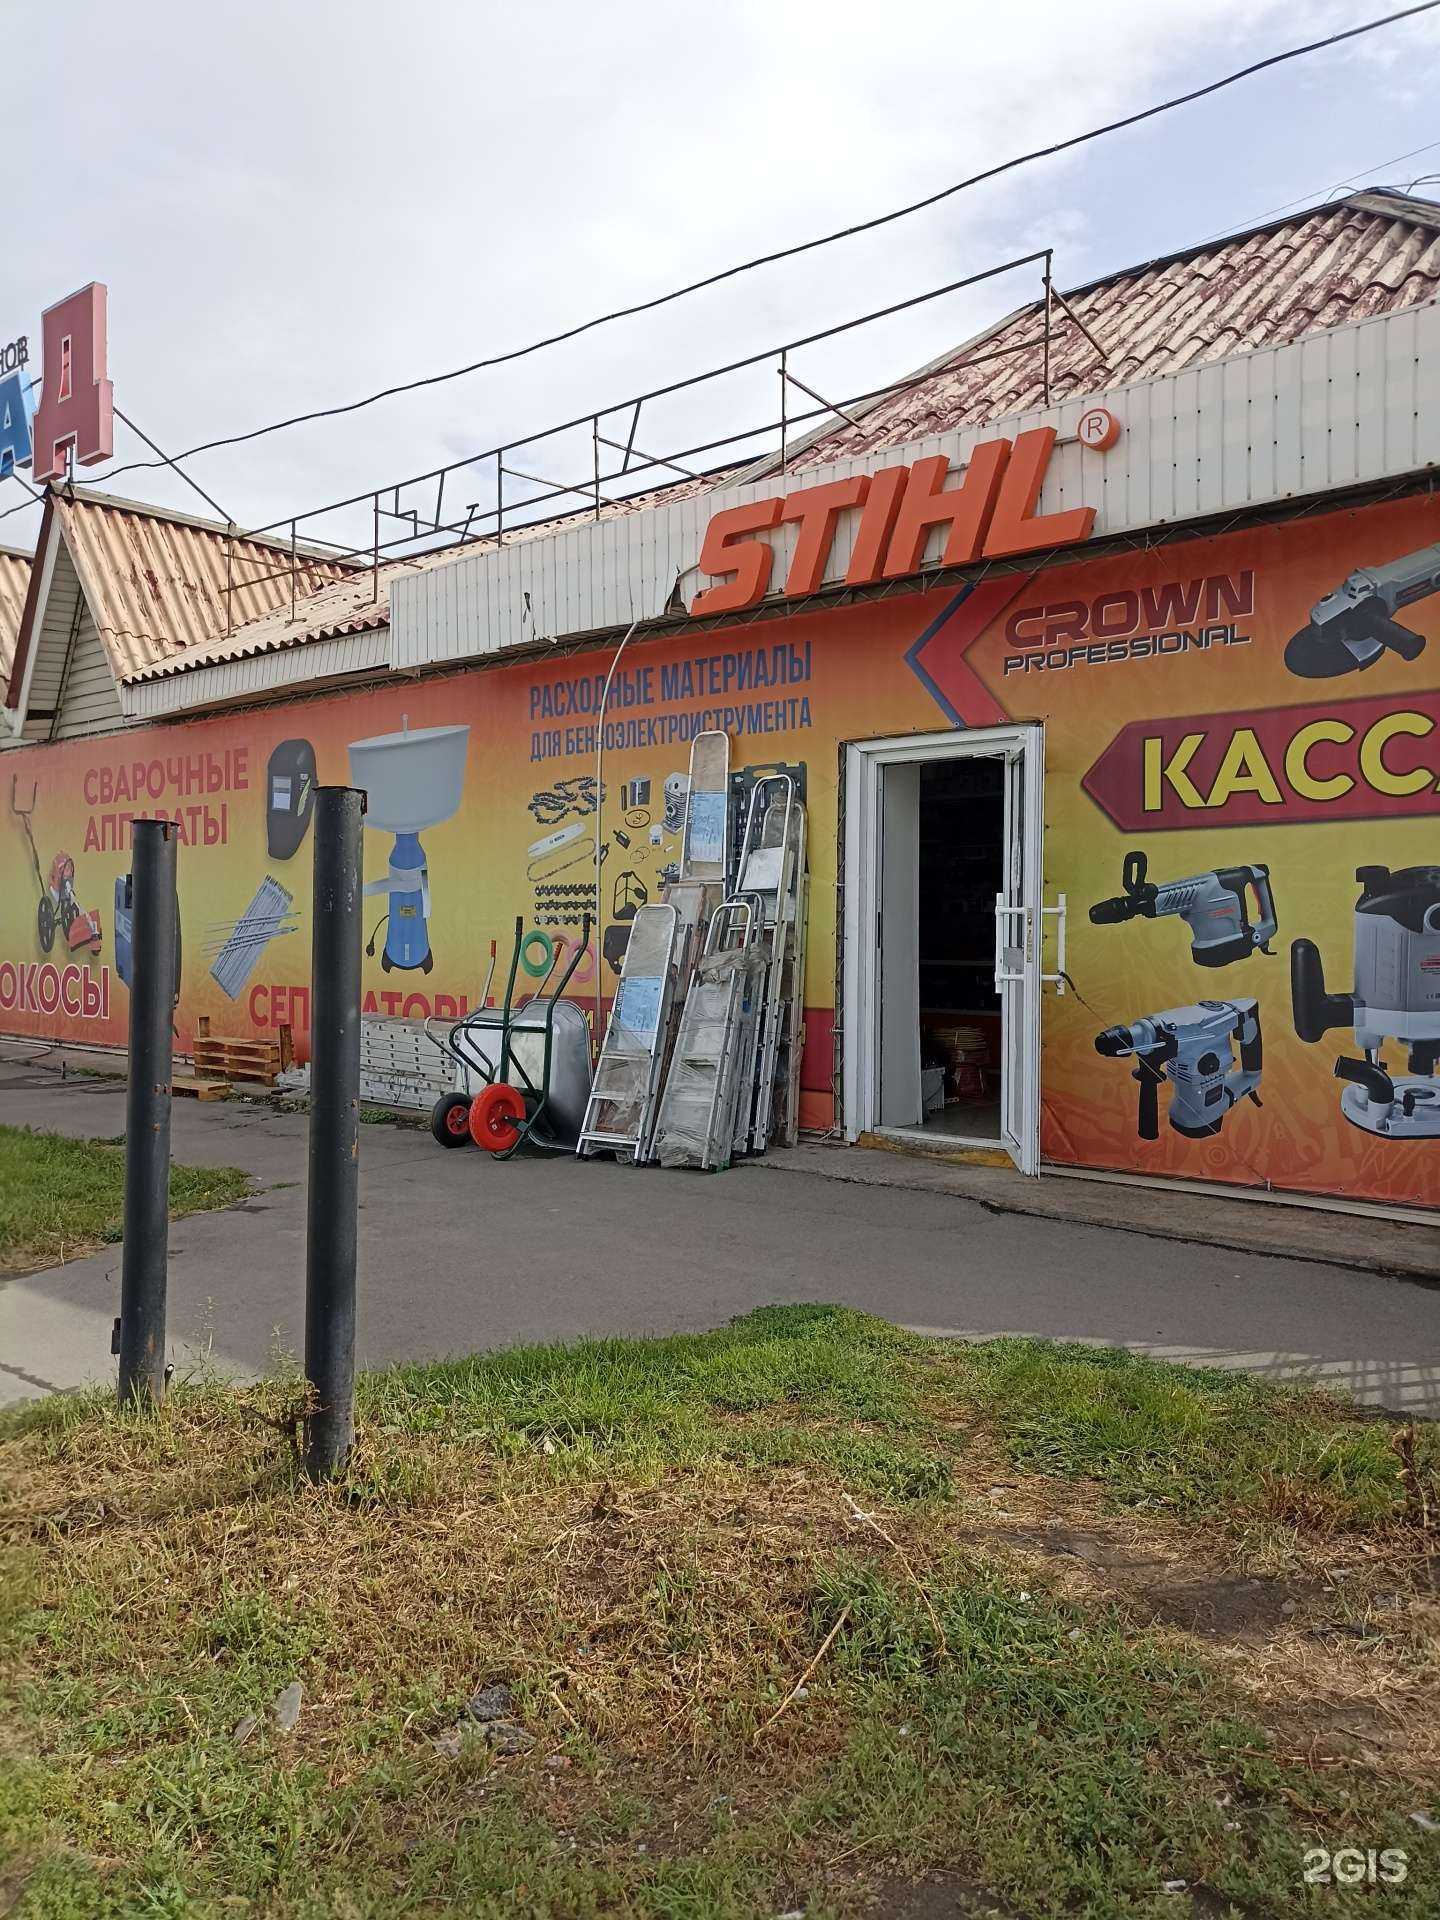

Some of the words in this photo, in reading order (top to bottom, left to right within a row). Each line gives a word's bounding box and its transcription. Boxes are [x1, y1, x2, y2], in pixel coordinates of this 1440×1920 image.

[691, 426, 1097, 615] STIHL
[1004, 570, 1255, 649] CROWN
[1003, 622, 1252, 676] PROFESSIONAL
[529, 666, 655, 720] РАСХОДНЫЕ
[661, 640, 812, 701] МАТЕРИАЛЫ
[529, 728, 561, 763] ДЛЯ
[1143, 711, 1440, 813] КАСС
[84, 748, 249, 806] СВАРОЧНЫЕ
[83, 803, 228, 853] АППАТЫ
[0, 962, 111, 1020] ОКОСЫ
[249, 984, 495, 1031] СЕПАТО
